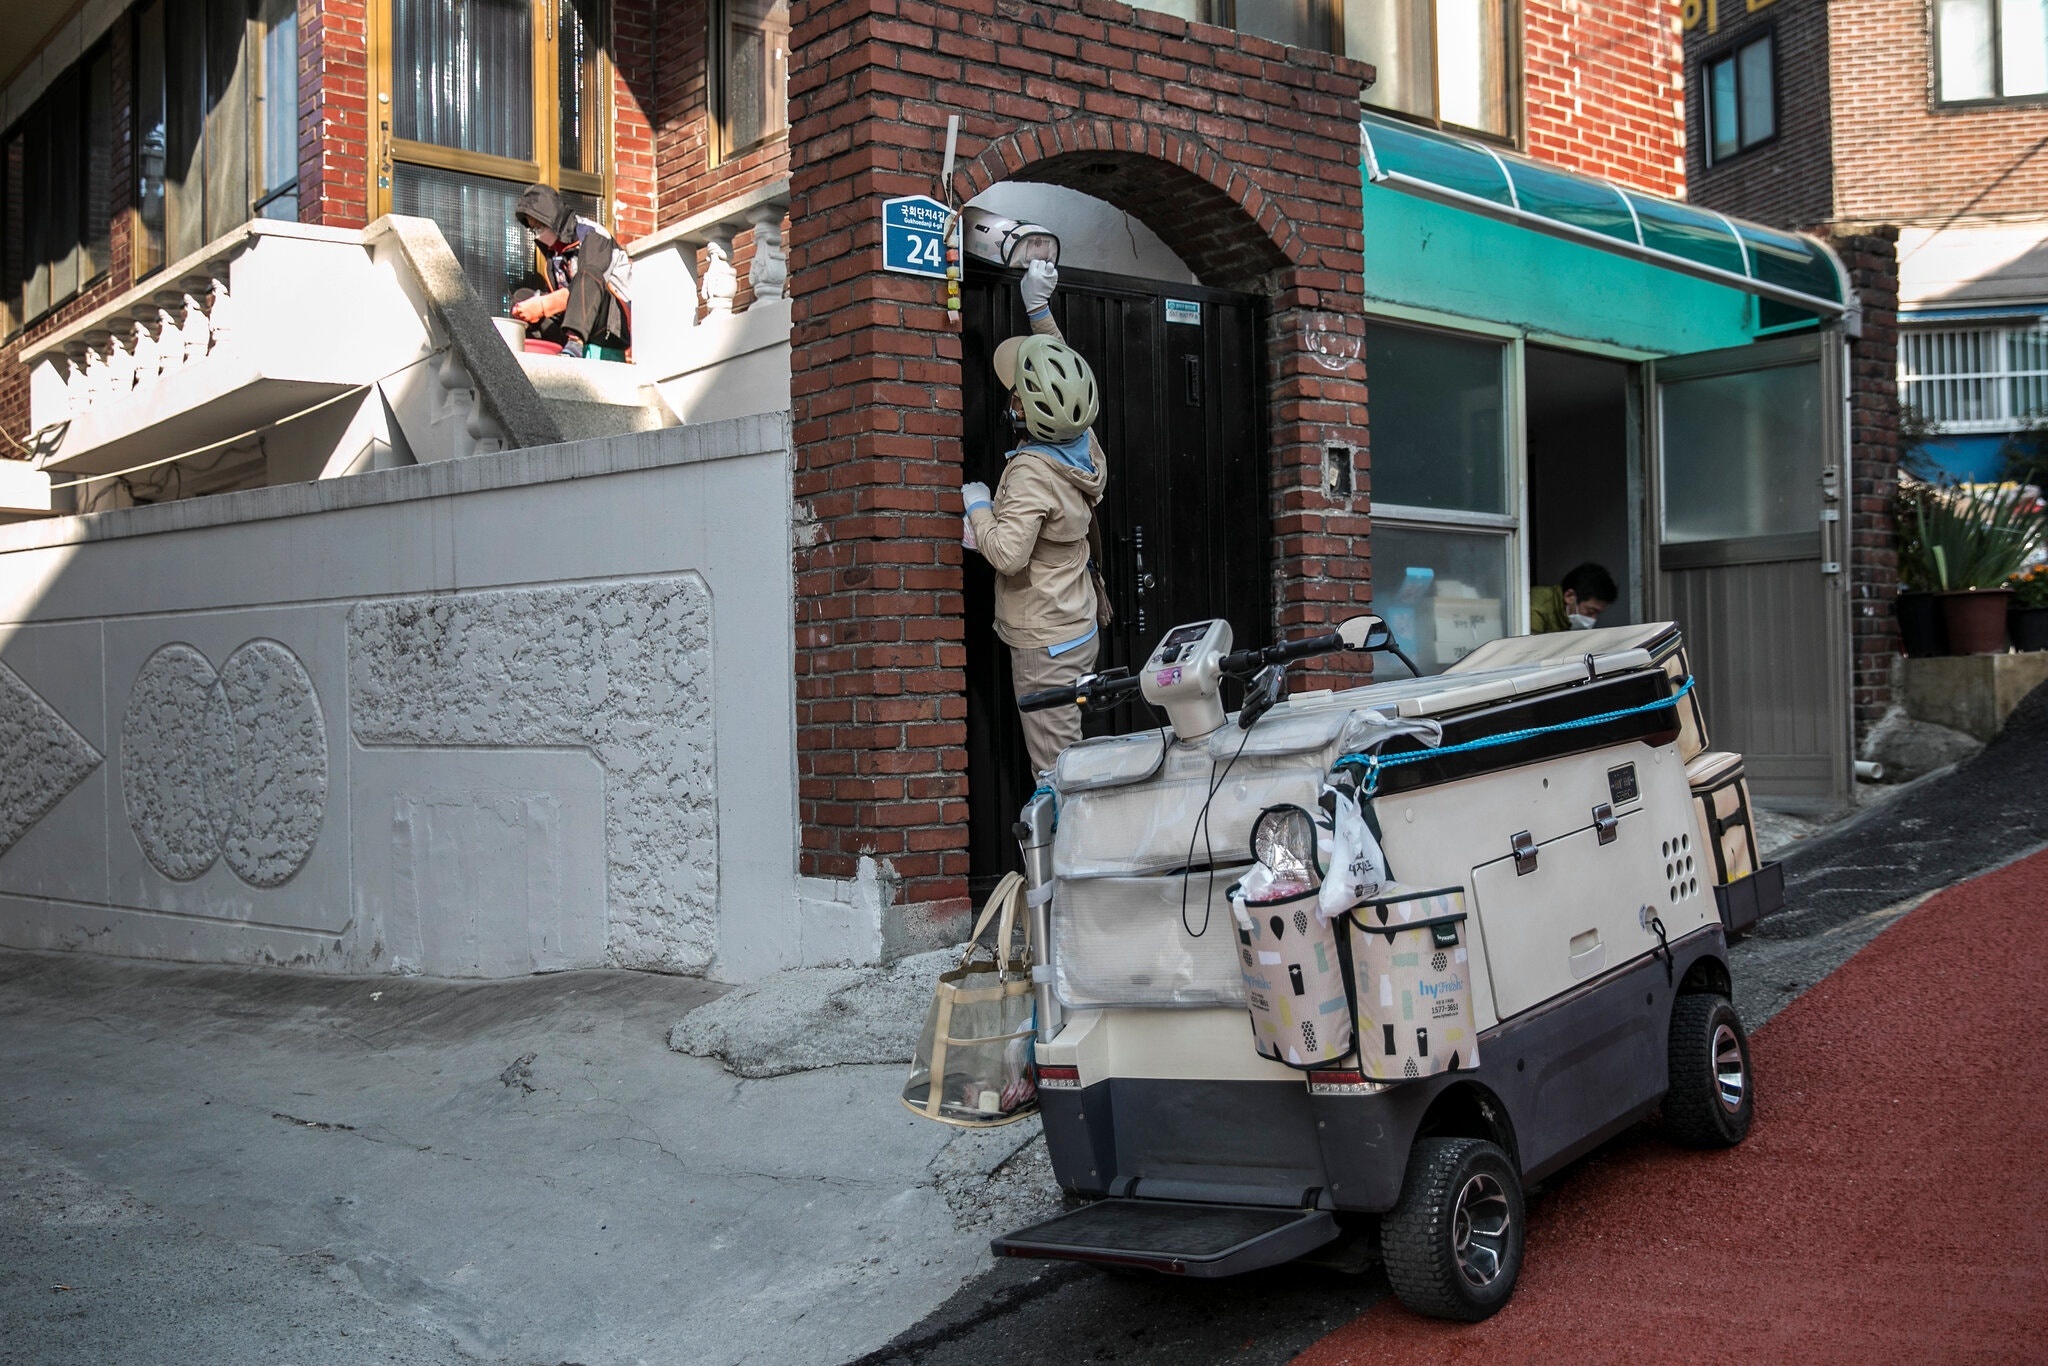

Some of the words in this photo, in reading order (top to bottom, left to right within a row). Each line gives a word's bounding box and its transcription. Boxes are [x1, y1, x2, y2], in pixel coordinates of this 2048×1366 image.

[901, 205, 944, 223] 국회단지4길
[907, 235, 941, 267] 24
[1432, 1004, 1458, 1014] 1577-3651
